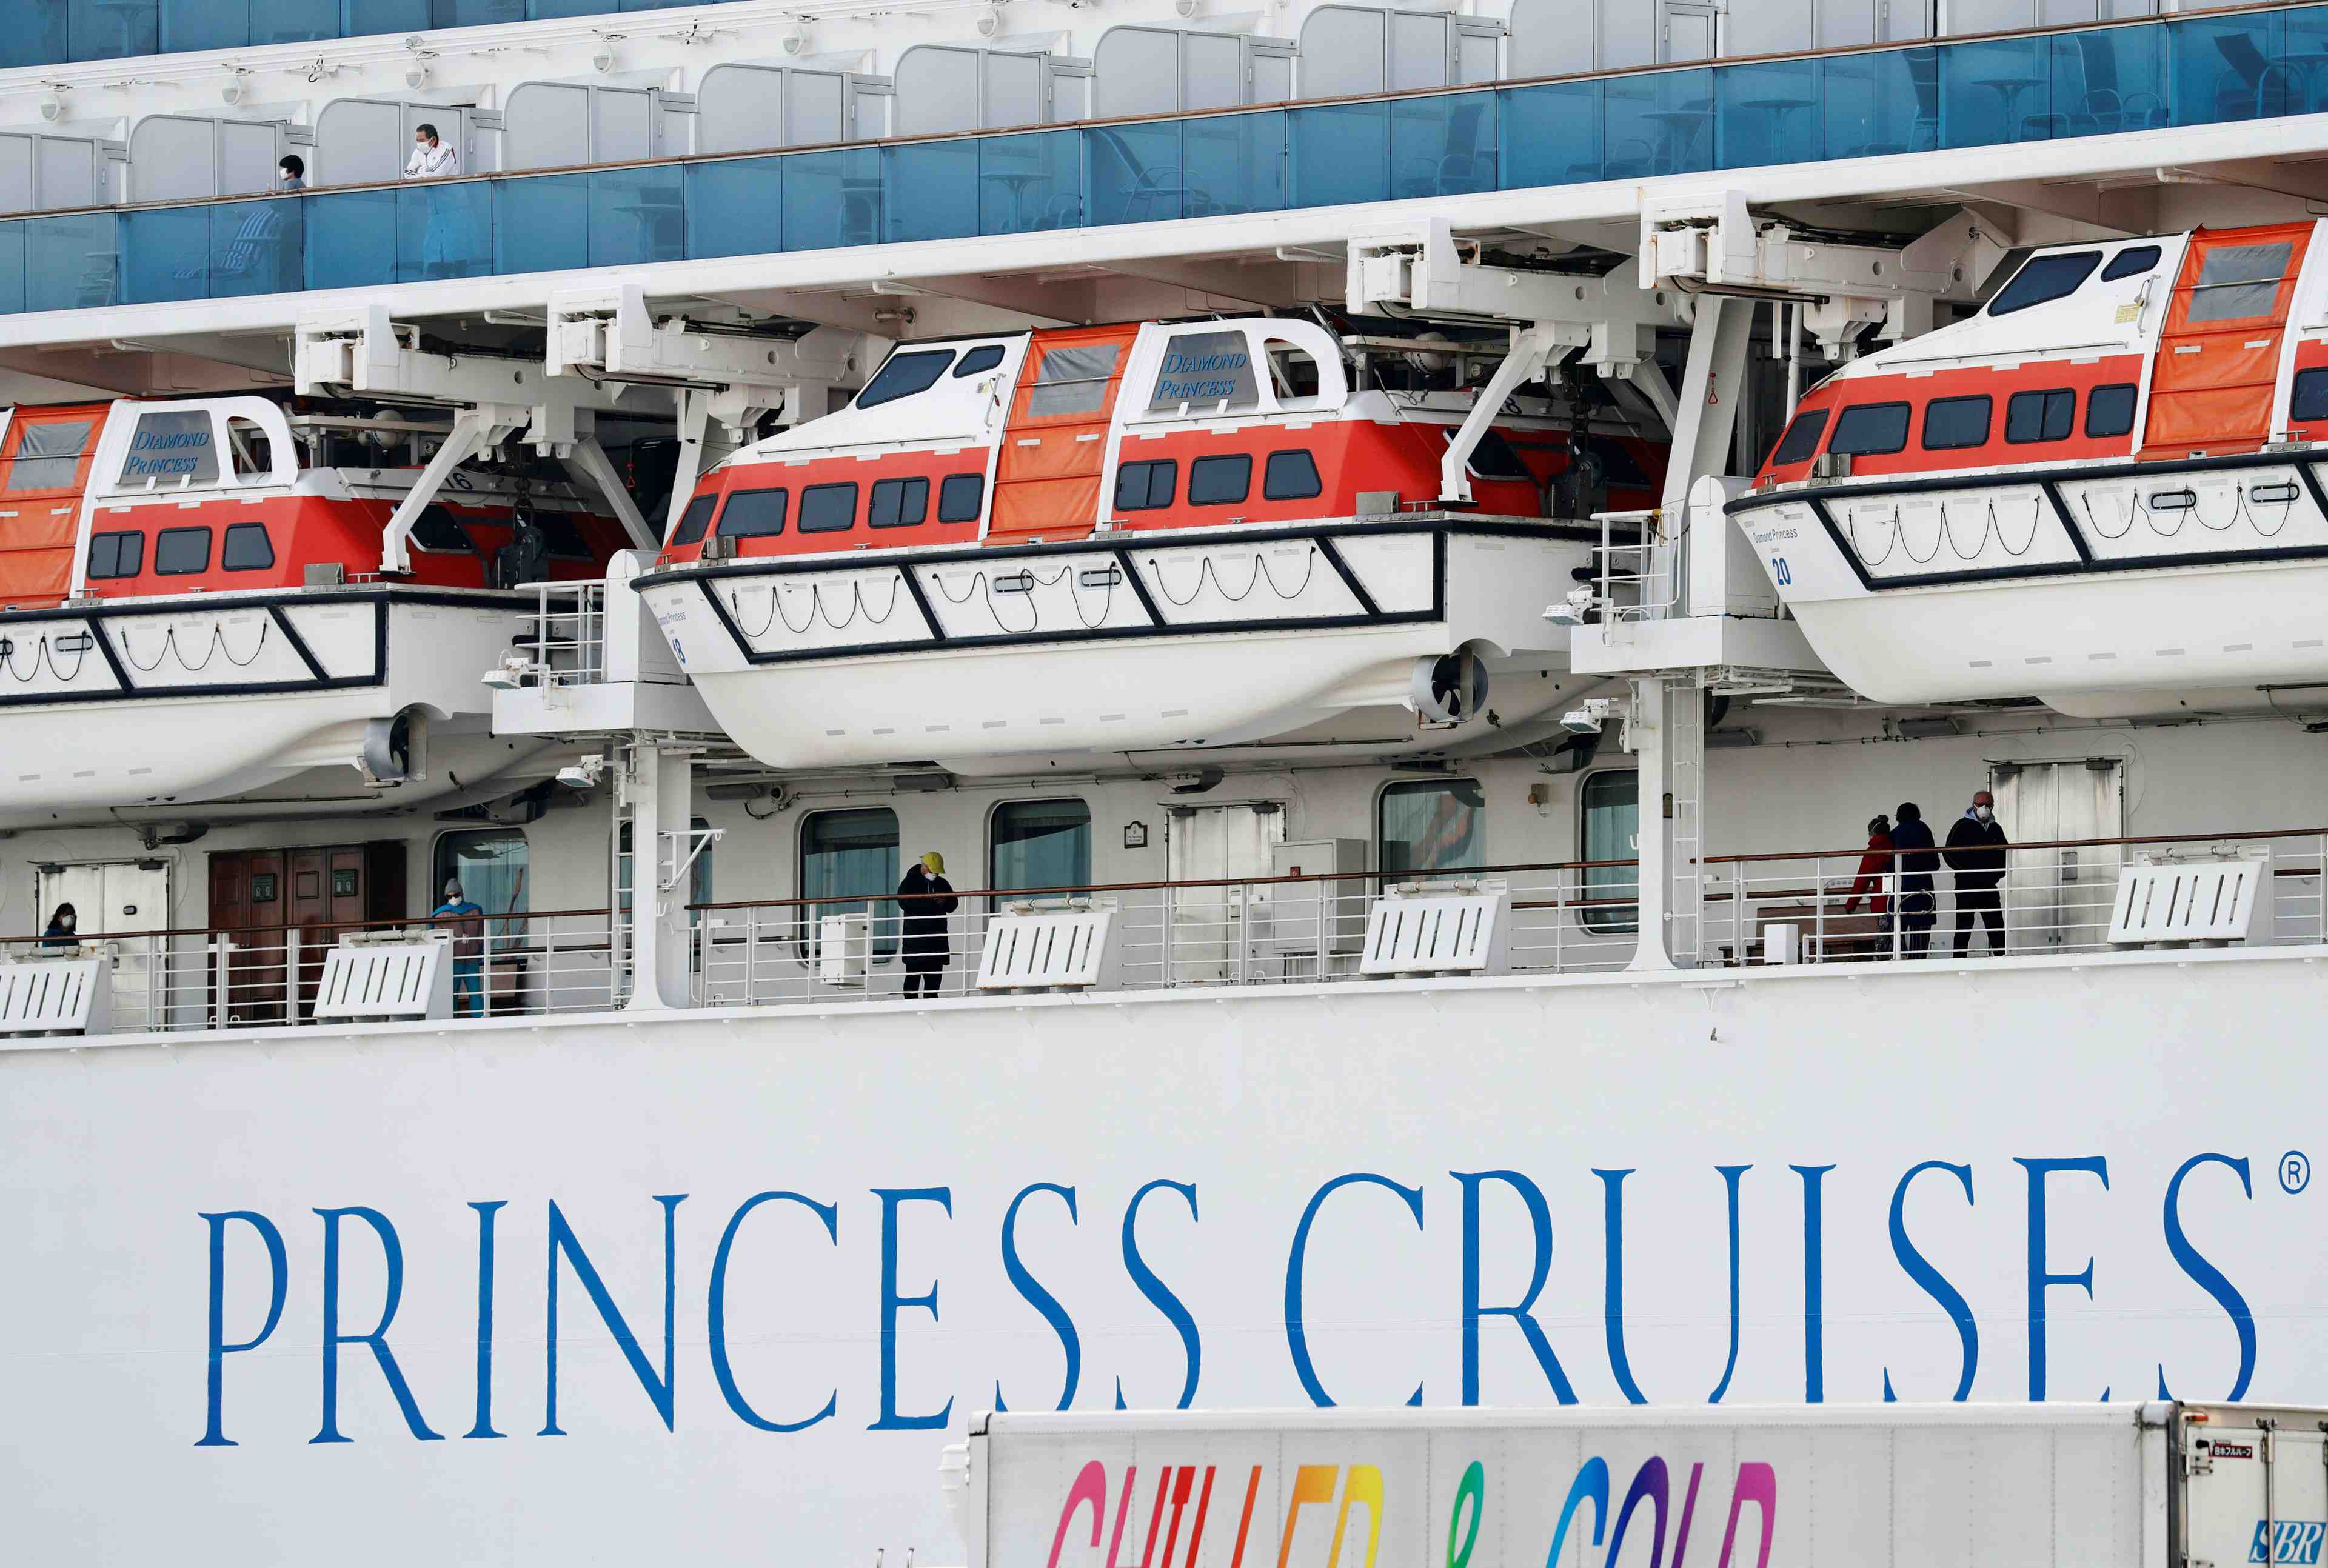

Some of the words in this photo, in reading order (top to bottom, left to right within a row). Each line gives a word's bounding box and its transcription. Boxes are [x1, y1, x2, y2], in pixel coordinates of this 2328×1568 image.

[1772, 557, 1791, 585] 20
[194, 1179, 1201, 1446] PRINCESS
[2250, 1522, 2322, 1562] SBR
